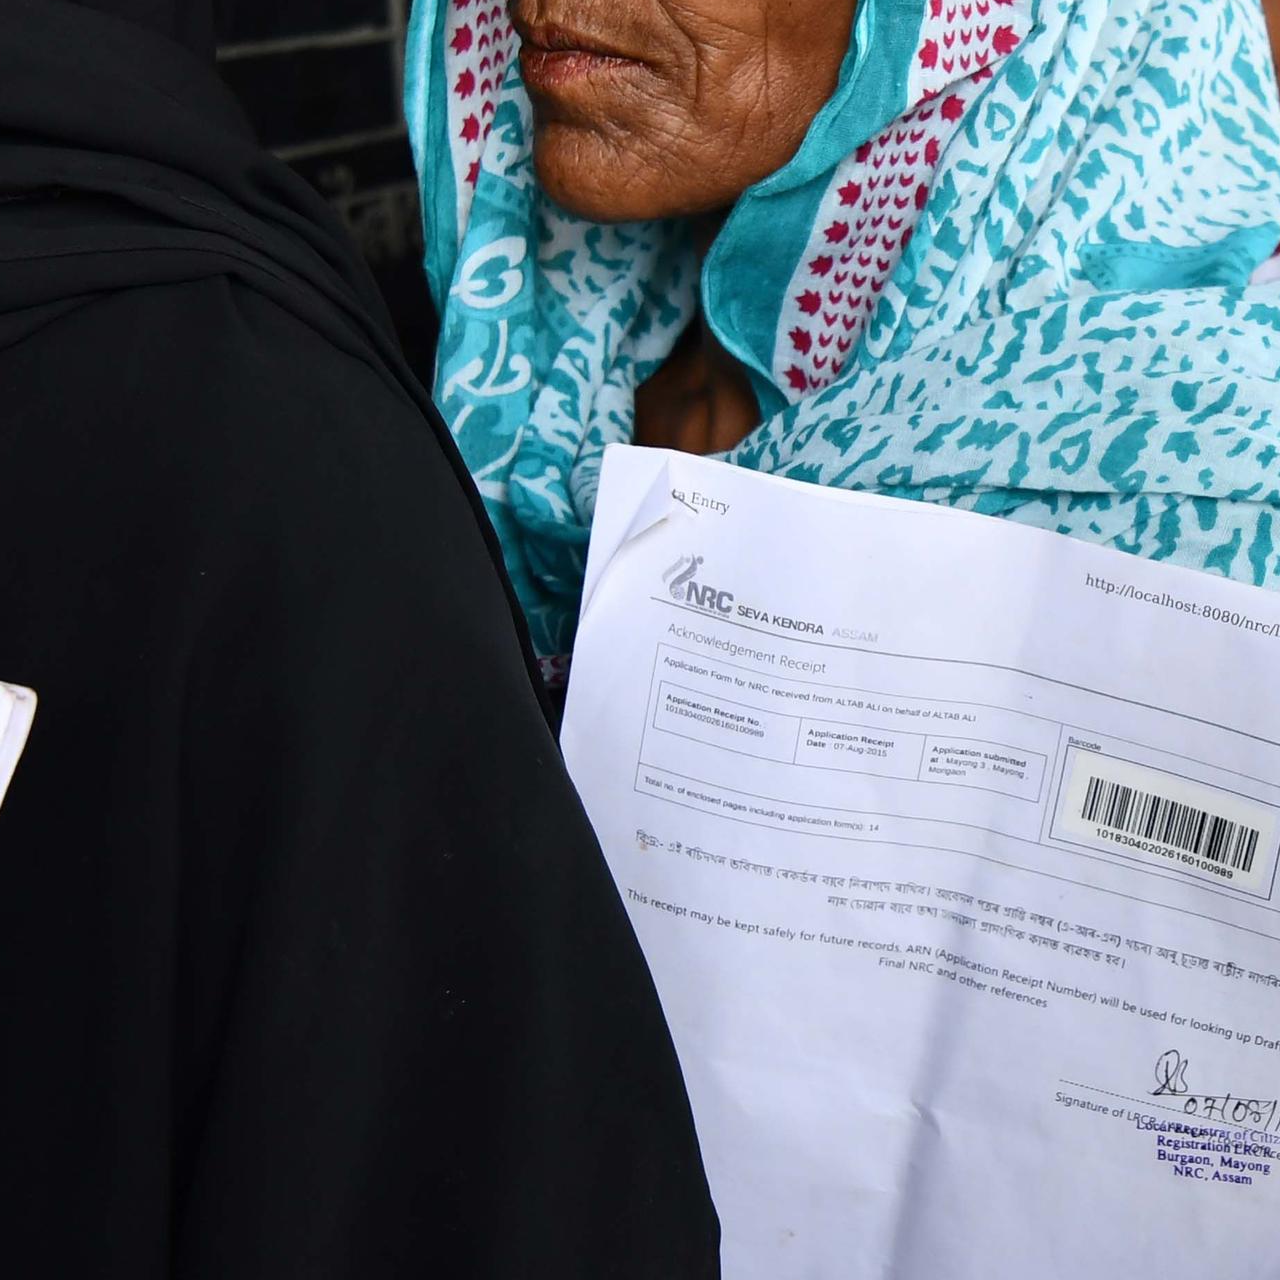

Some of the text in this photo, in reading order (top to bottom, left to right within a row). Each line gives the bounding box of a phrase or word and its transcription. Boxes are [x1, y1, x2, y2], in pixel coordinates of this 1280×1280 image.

[691, 492, 730, 516] Entry
[686, 580, 734, 613] NRC
[737, 605, 769, 625] SEVA
[772, 614, 824, 636] KENDRA
[831, 626, 880, 645] ASSAM
[667, 623, 827, 675] Acknowledgement Receipt
[664, 656, 708, 677] Application
[711, 670, 732, 682] Form
[734, 677, 746, 687] for
[748, 680, 769, 694] NRC
[771, 687, 810, 701] received
[812, 693, 833, 704] from
[835, 698, 864, 709] ALTAB
[882, 706, 893, 715] on
[895, 707, 920, 718] behalf
[922, 710, 931, 719] of
[666, 694, 712, 714] Application
[714, 708, 745, 725] Receipt
[806, 738, 826, 748] Date
[808, 728, 895, 748] Application Receipt
[1068, 736, 1102, 751] Barcode
[930, 756, 939, 765] at
[946, 756, 978, 770] Mayong
[932, 745, 1027, 768] Application submitted
[644, 776, 662, 789] Total
[677, 786, 686, 795] of
[686, 788, 722, 804] enclosed
[722, 799, 747, 813] pages
[749, 805, 786, 821] including
[787, 813, 832, 827] application
[1096, 828, 1234, 880] 101830402026160100989
[627, 888, 648, 904] This
[650, 895, 687, 918] receipt
[690, 909, 714, 926] may
[717, 913, 731, 928] be
[734, 919, 760, 935] kept
[762, 924, 796, 941] safely
[799, 928, 816, 942] for
[819, 933, 854, 947] future
[906, 944, 931, 957] ARN
[935, 948, 999, 978] (Application
[1002, 968, 1044, 990] Receipt
[1047, 980, 1098, 1004] Number)
[1100, 994, 1120, 1009] will
[1122, 999, 1137, 1014] be
[1140, 1005, 1167, 1022] used
[1170, 1012, 1187, 1026] for
[1190, 1018, 1233, 1040] looking
[1236, 1030, 1251, 1045] up
[879, 956, 1048, 1009] Final NRC and other references
[1055, 1091, 1109, 1115] Signature
[1112, 1107, 1124, 1119] of
[1157, 1135, 1231, 1154] Registration
[1157, 1150, 1271, 1176] Burgaon, Mayong
[1212, 1170, 1253, 1185] Assam
